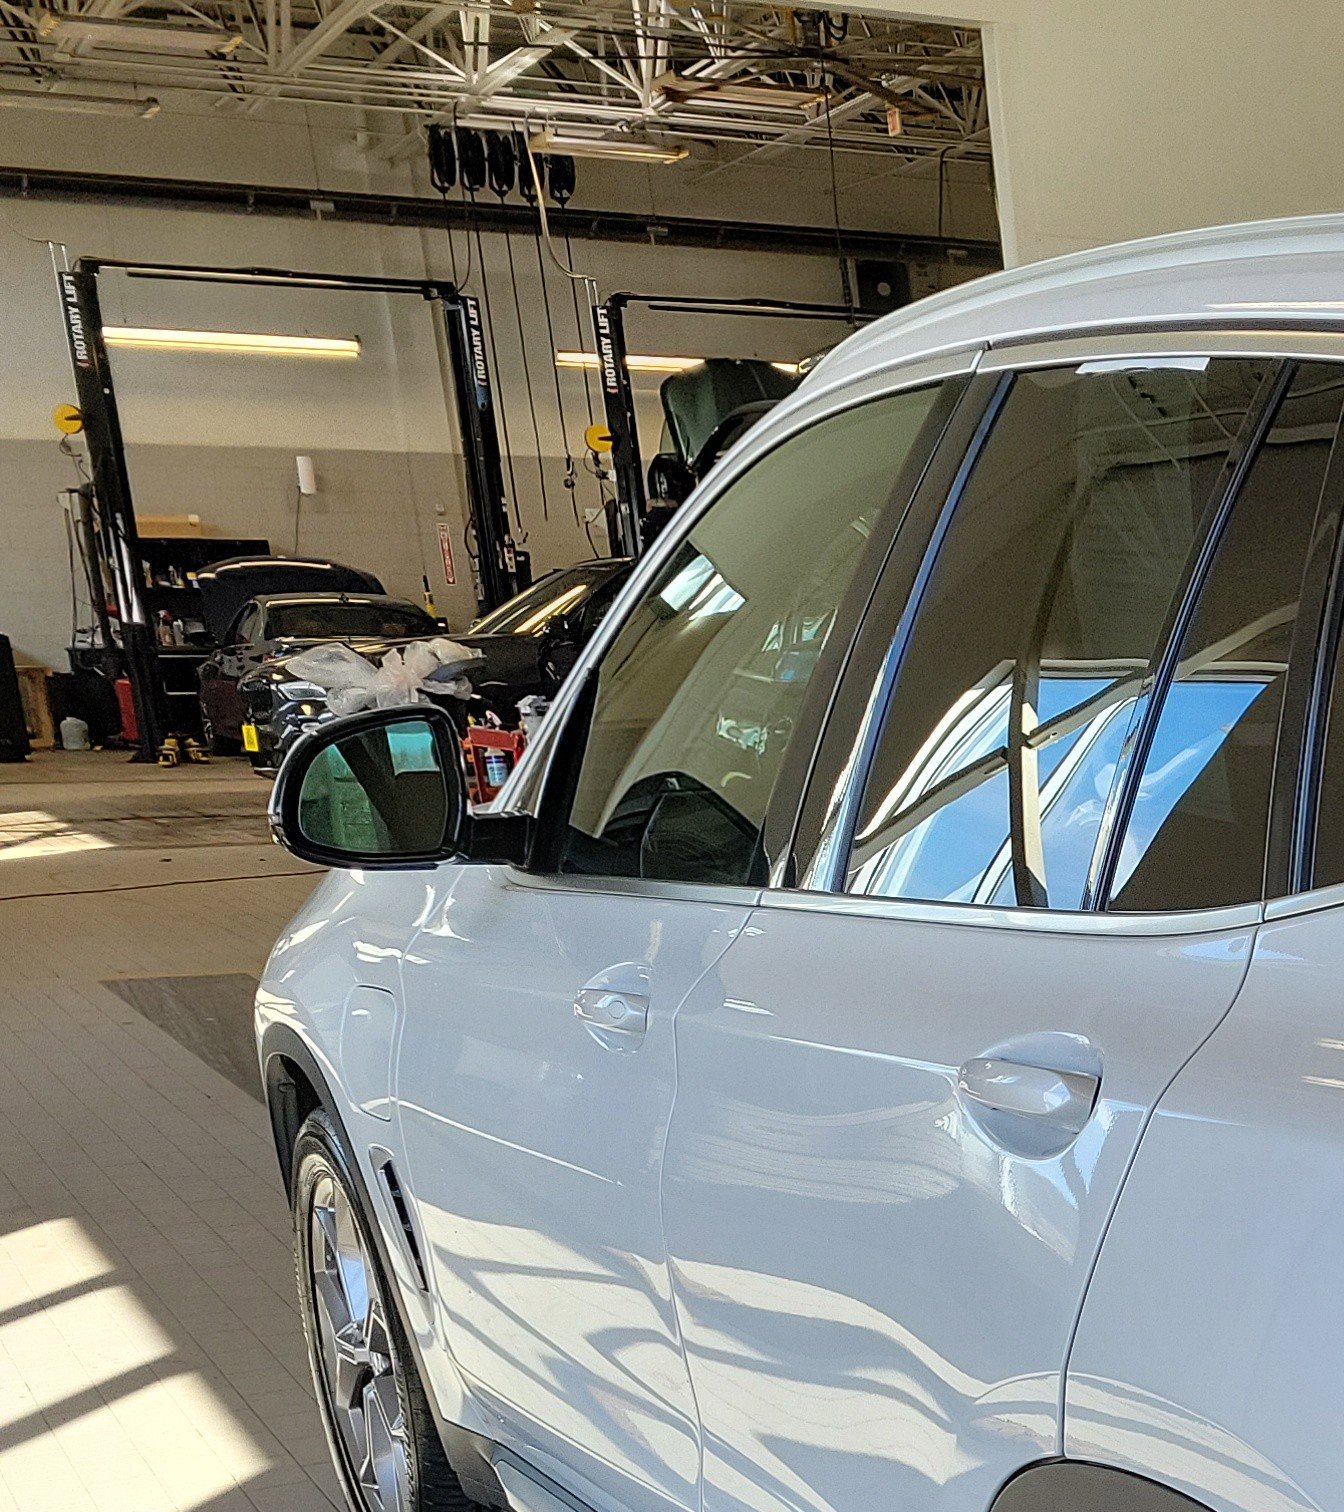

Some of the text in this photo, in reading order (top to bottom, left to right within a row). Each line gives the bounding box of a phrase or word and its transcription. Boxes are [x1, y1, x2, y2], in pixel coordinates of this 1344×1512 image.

[62, 273, 88, 360] ROTARY LIFT
[466, 298, 487, 379] ROTARY LIFT
[596, 306, 617, 387] ROTARY LIFT
